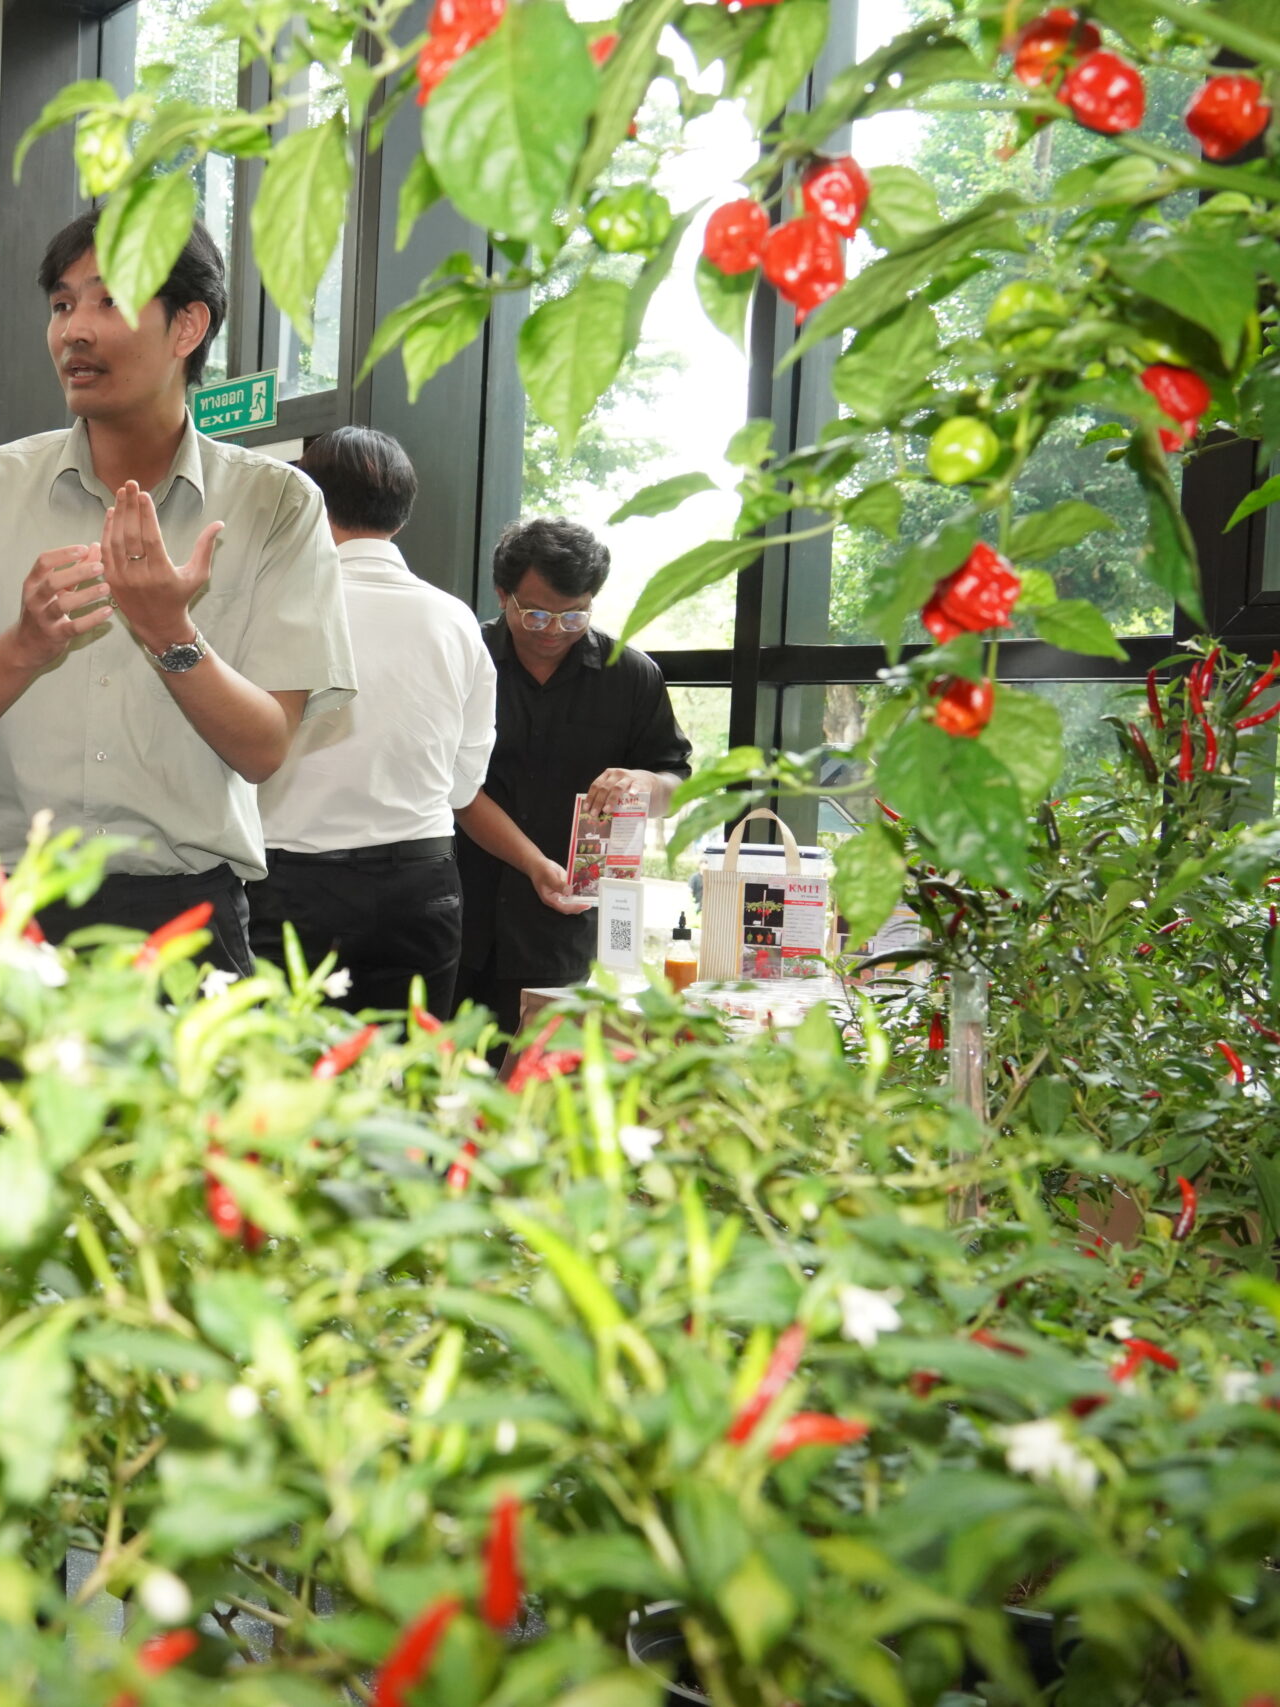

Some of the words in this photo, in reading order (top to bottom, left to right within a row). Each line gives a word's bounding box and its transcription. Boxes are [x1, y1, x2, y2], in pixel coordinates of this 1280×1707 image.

[200, 389, 244, 411] ทางออก
[200, 410, 243, 427] EXIT
[788, 884, 819, 894] KM11
